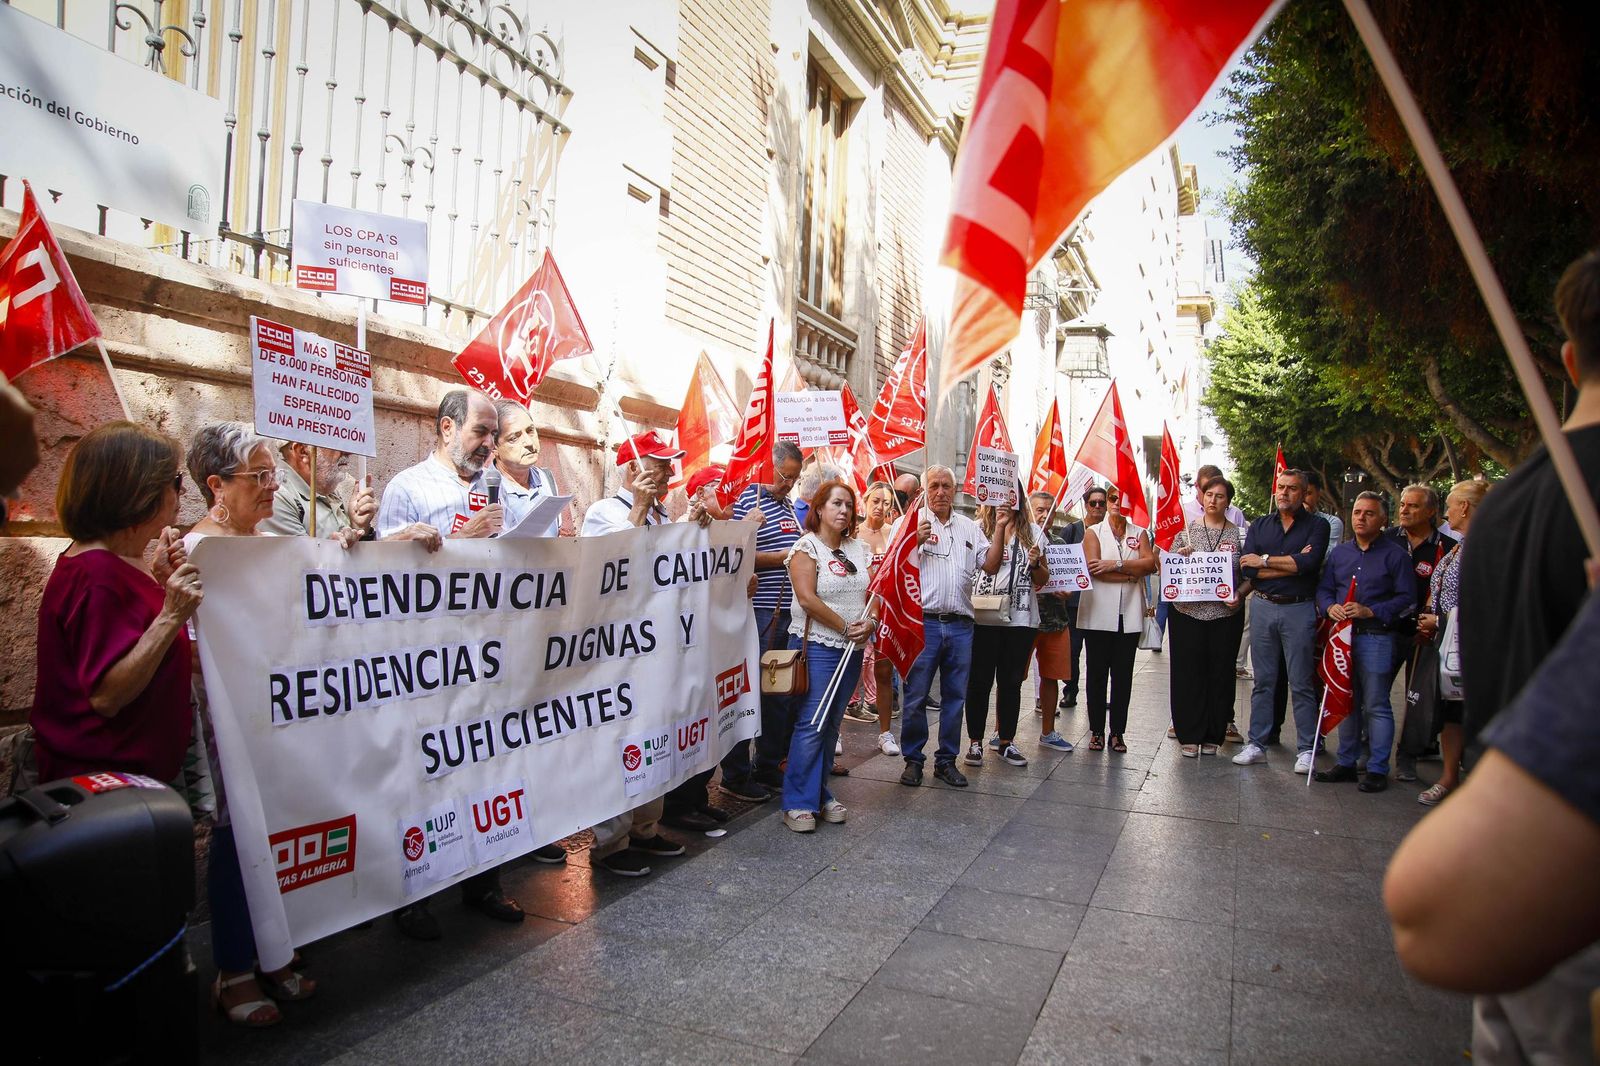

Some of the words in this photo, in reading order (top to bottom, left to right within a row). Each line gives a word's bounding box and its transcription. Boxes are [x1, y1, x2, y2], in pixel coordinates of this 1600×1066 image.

[47, 101, 71, 120] del
[74, 112, 139, 145] Gobierno
[325, 223, 353, 238] LOS
[324, 240, 342, 251] sin
[346, 244, 399, 261] personal
[298, 269, 335, 281] CCOO
[328, 257, 395, 275] suficientes
[391, 282, 425, 294] CCOO
[258, 324, 292, 343] CCOO
[258, 336, 293, 350] pensionistas
[303, 342, 328, 359] MÁS
[335, 345, 370, 365] CCOO
[259, 349, 276, 363] DE
[279, 354, 307, 372] 8.000
[310, 363, 367, 389] PERSONAS
[272, 372, 297, 389] HAN
[299, 379, 360, 404] FALLECIDO
[283, 395, 352, 421] ESPERANDO
[268, 411, 294, 428] UNA
[297, 418, 366, 443] PRESTACIÓN
[981, 465, 990, 473] DE
[990, 465, 999, 474] LA
[600, 558, 629, 595] DE
[653, 546, 743, 587] CALIDAD
[1170, 567, 1187, 575] LAS
[1191, 566, 1223, 574] LISTAS
[1170, 577, 1183, 585] DE
[1186, 576, 1224, 585] ESPERA
[305, 571, 567, 620] DEPENDENCIA
[544, 620, 657, 671] DIGNAS
[679, 613, 694, 645] Y
[270, 640, 501, 723] RESIDENCIAS
[421, 682, 633, 774] SUFICIENTES
[678, 717, 709, 752] UGT
[652, 734, 669, 751] UJP
[472, 788, 524, 833] UGT
[434, 811, 456, 833] UJP
[485, 826, 520, 846] Andalucía
[300, 858, 347, 881] ALMERÍA
